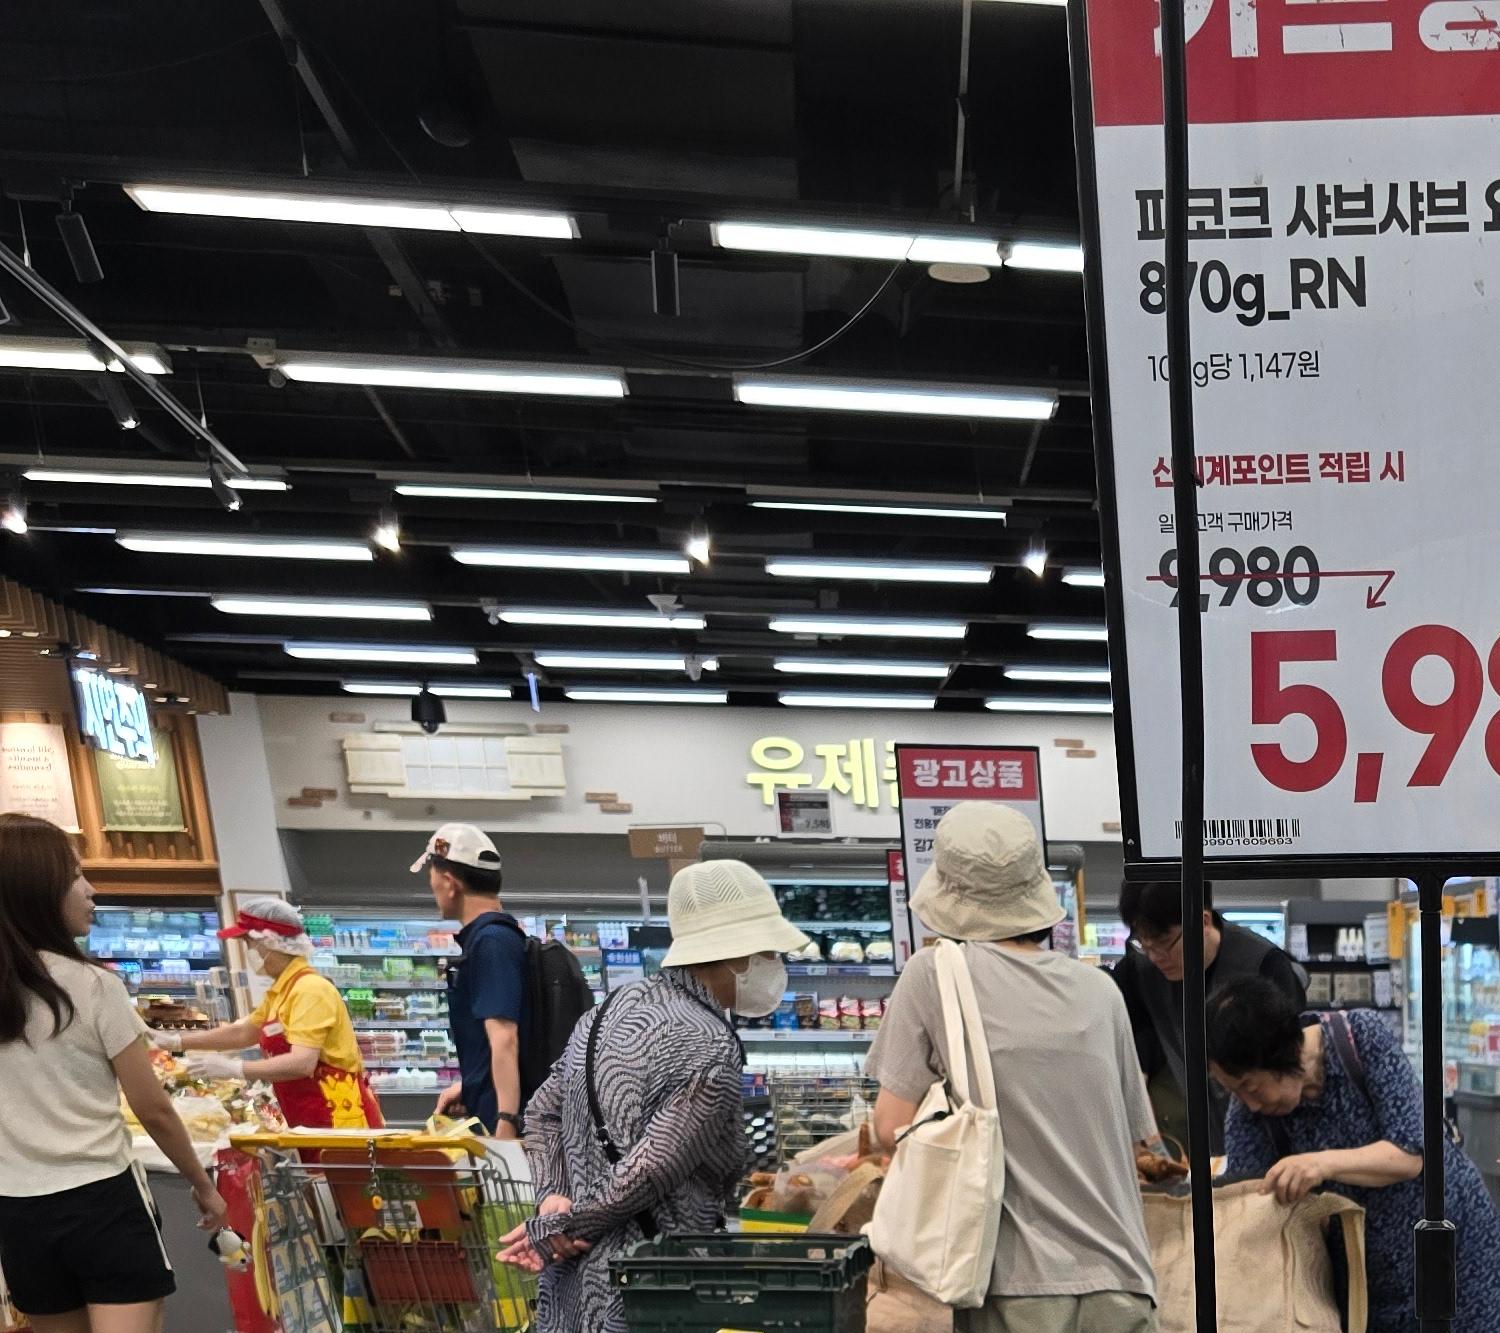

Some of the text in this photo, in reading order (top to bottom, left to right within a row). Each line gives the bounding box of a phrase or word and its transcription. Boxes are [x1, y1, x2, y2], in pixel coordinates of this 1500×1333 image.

[1286, 180, 1470, 238] 샤브샤브
[1147, 350, 1321, 388] 10g당 1,147원
[1318, 451, 1371, 484] 적립
[1381, 451, 1406, 483] 시
[1158, 510, 1294, 533] 일고객 구매가격
[912, 758, 1024, 789] 광고상품
